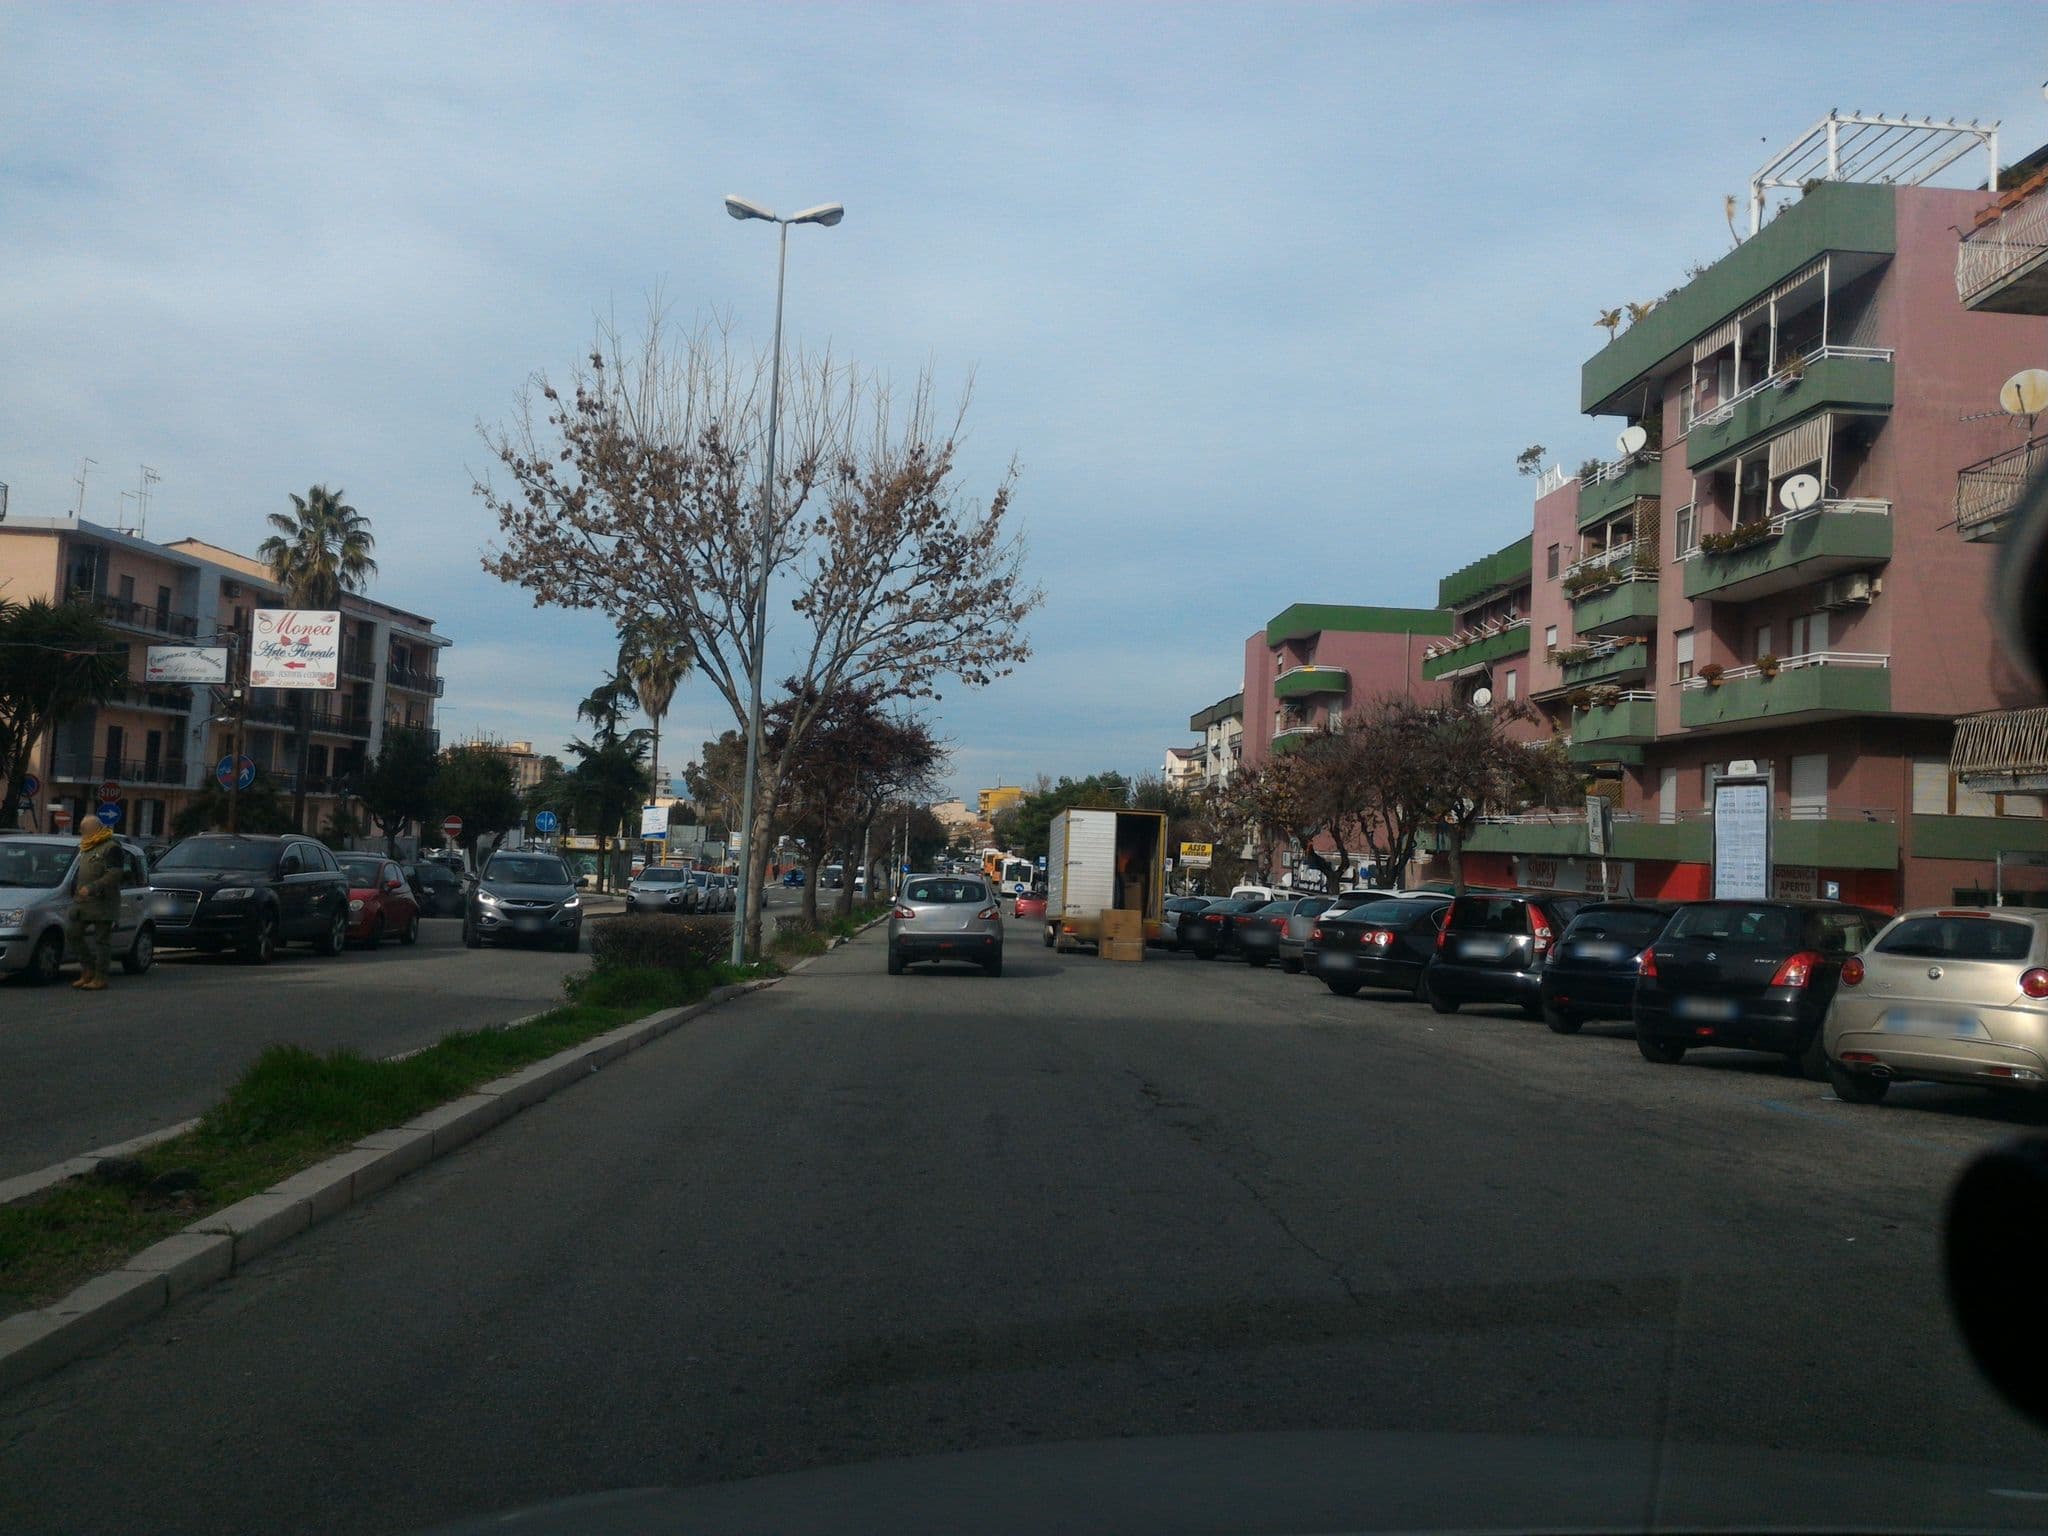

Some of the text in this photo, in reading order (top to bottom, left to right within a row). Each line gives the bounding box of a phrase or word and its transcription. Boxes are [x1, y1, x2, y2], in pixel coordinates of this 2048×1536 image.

[260, 612, 333, 636] Monea
[254, 641, 336, 659] Arte Floreale
[100, 787, 120, 797] STOP
[1187, 844, 1207, 852] ASSO
[1780, 881, 1809, 892] APERTO
[1828, 884, 1838, 897] P
